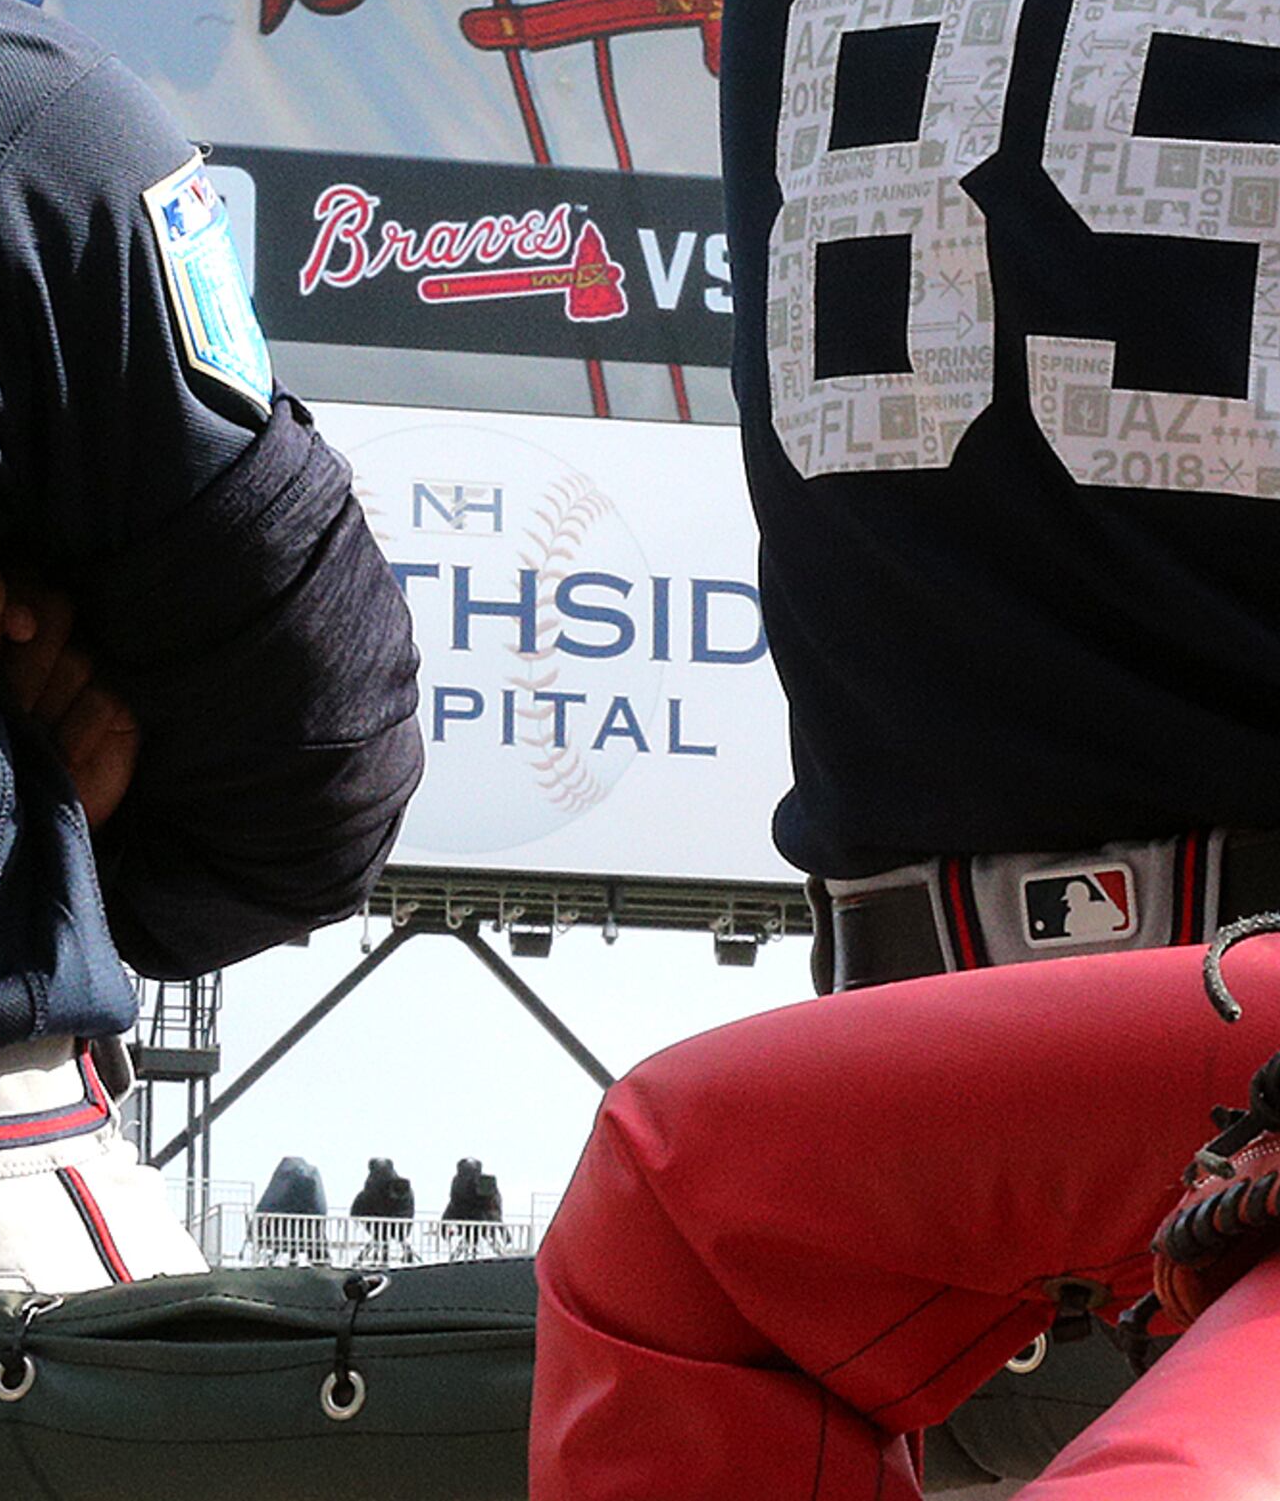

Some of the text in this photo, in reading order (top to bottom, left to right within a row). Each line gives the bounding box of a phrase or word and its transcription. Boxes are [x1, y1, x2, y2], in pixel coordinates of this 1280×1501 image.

[1080, 142, 1144, 196] FL
[1204, 147, 1279, 168] SPRING
[863, 180, 934, 203] TRAINING
[300, 184, 572, 296] Braves
[1040, 354, 1110, 375] SPRING
[821, 400, 873, 456] FL
[1120, 394, 1201, 444] AZ
[1092, 449, 1205, 488] 2018
